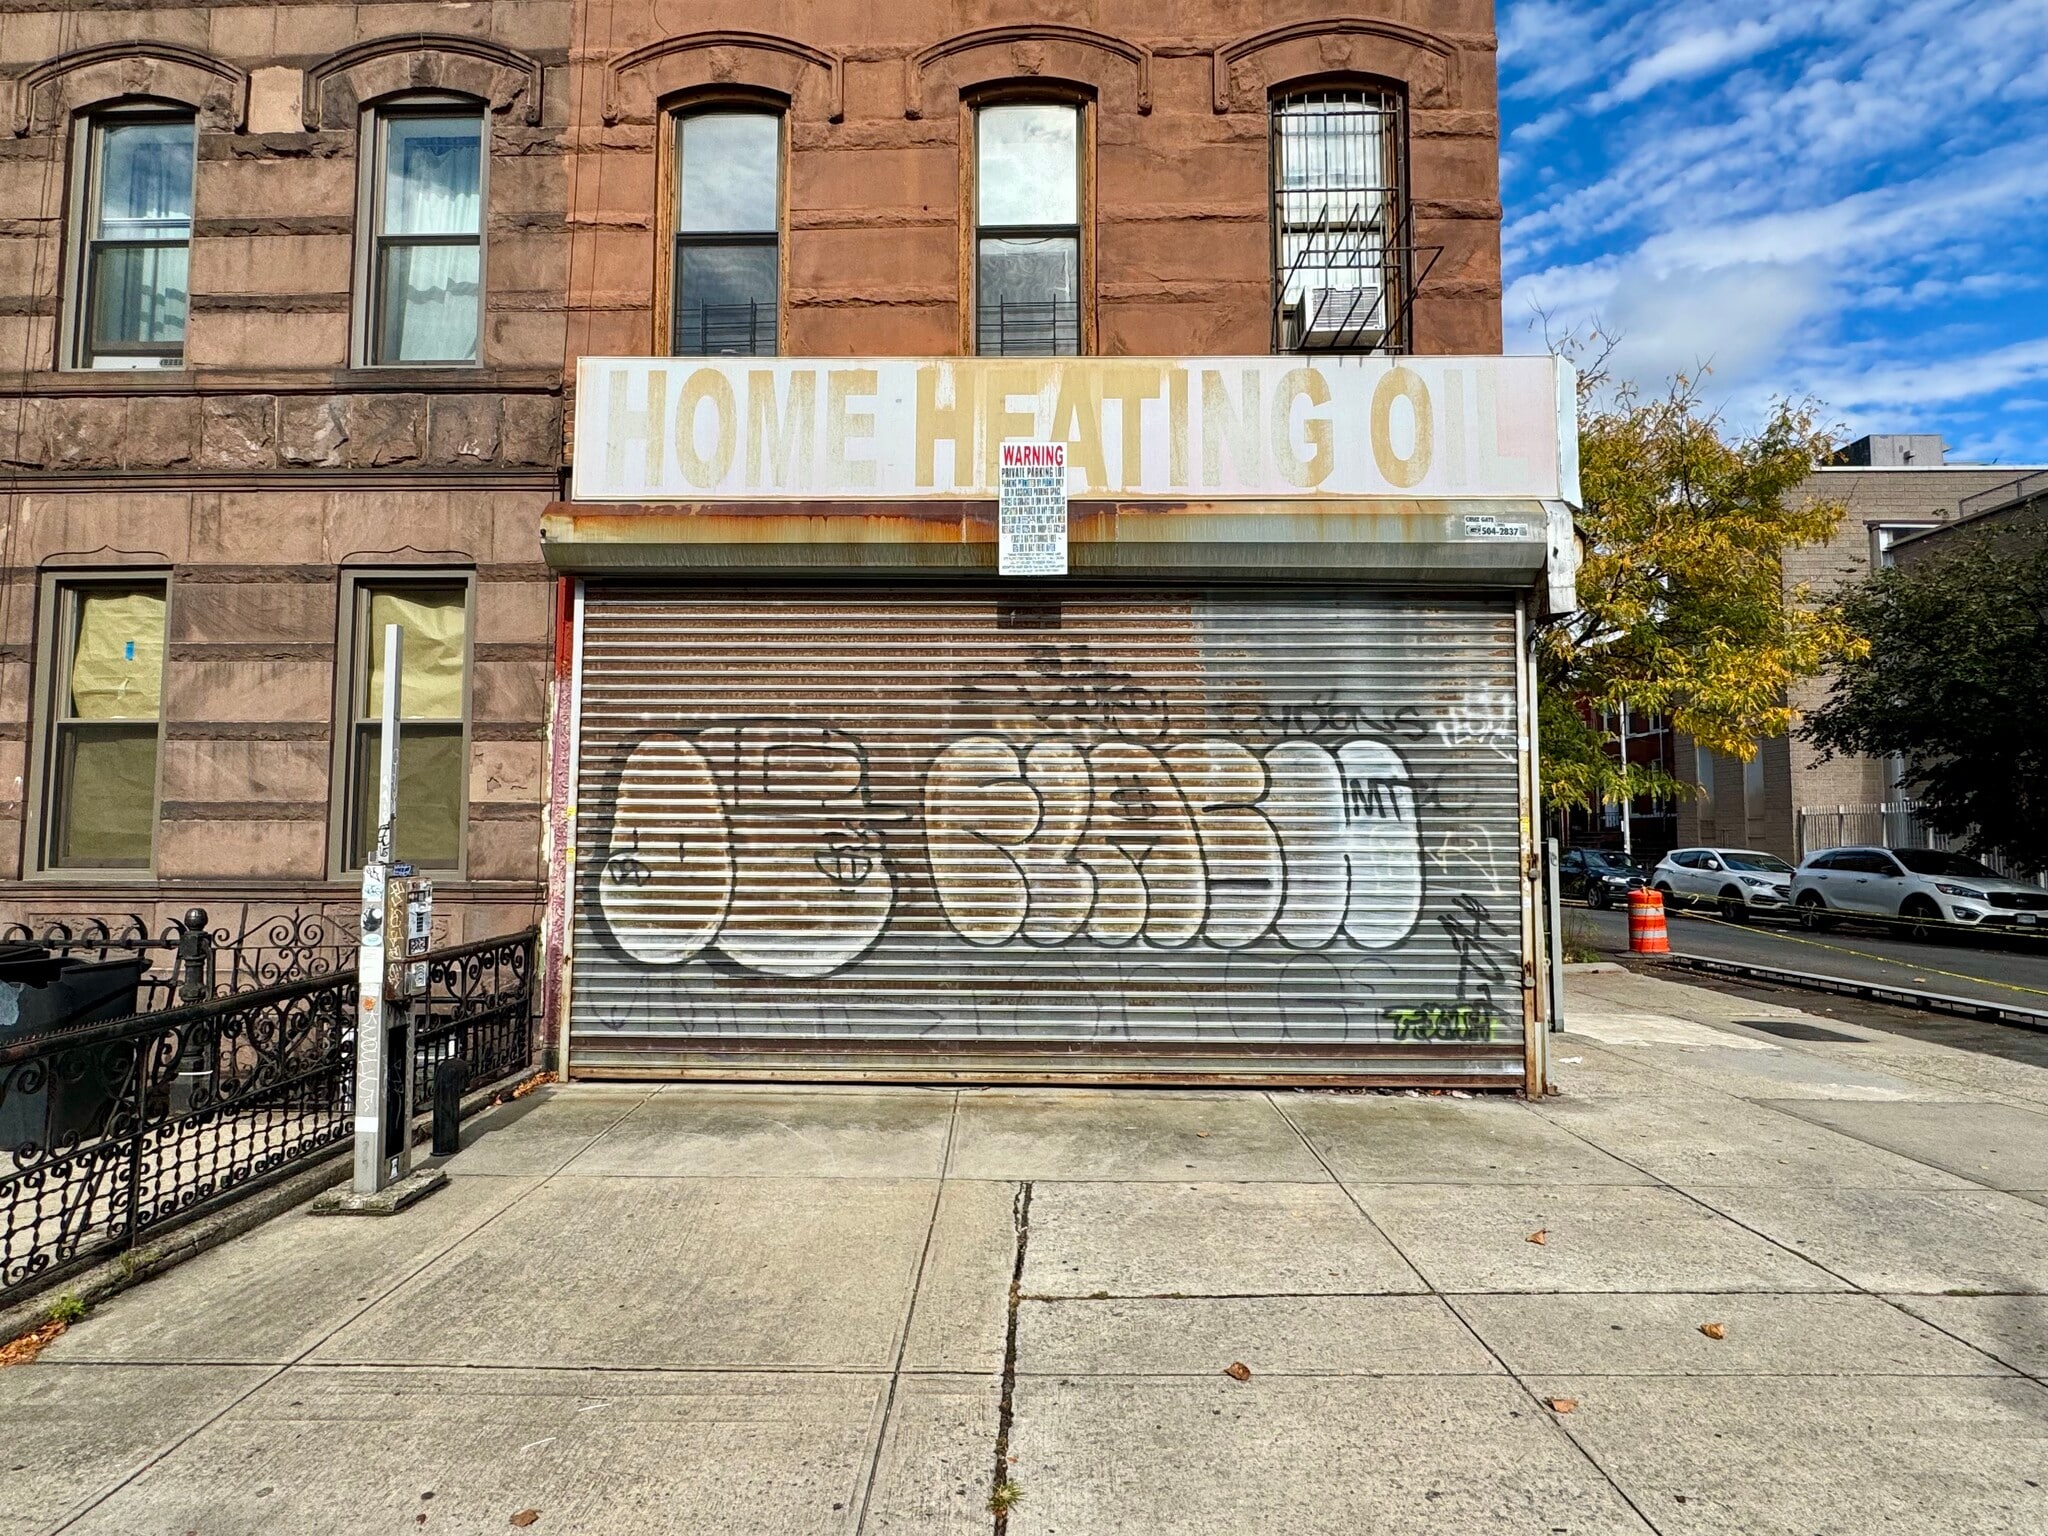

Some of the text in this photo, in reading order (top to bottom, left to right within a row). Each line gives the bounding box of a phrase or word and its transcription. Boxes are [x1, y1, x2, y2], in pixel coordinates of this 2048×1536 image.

[608, 366, 1530, 489] HOME HEATING OIL
[1004, 445, 1064, 466] WARNING
[1002, 467, 1025, 478] PRIVATE
[1027, 467, 1053, 477] PARKING
[1482, 527, 1518, 535] 504-2837
